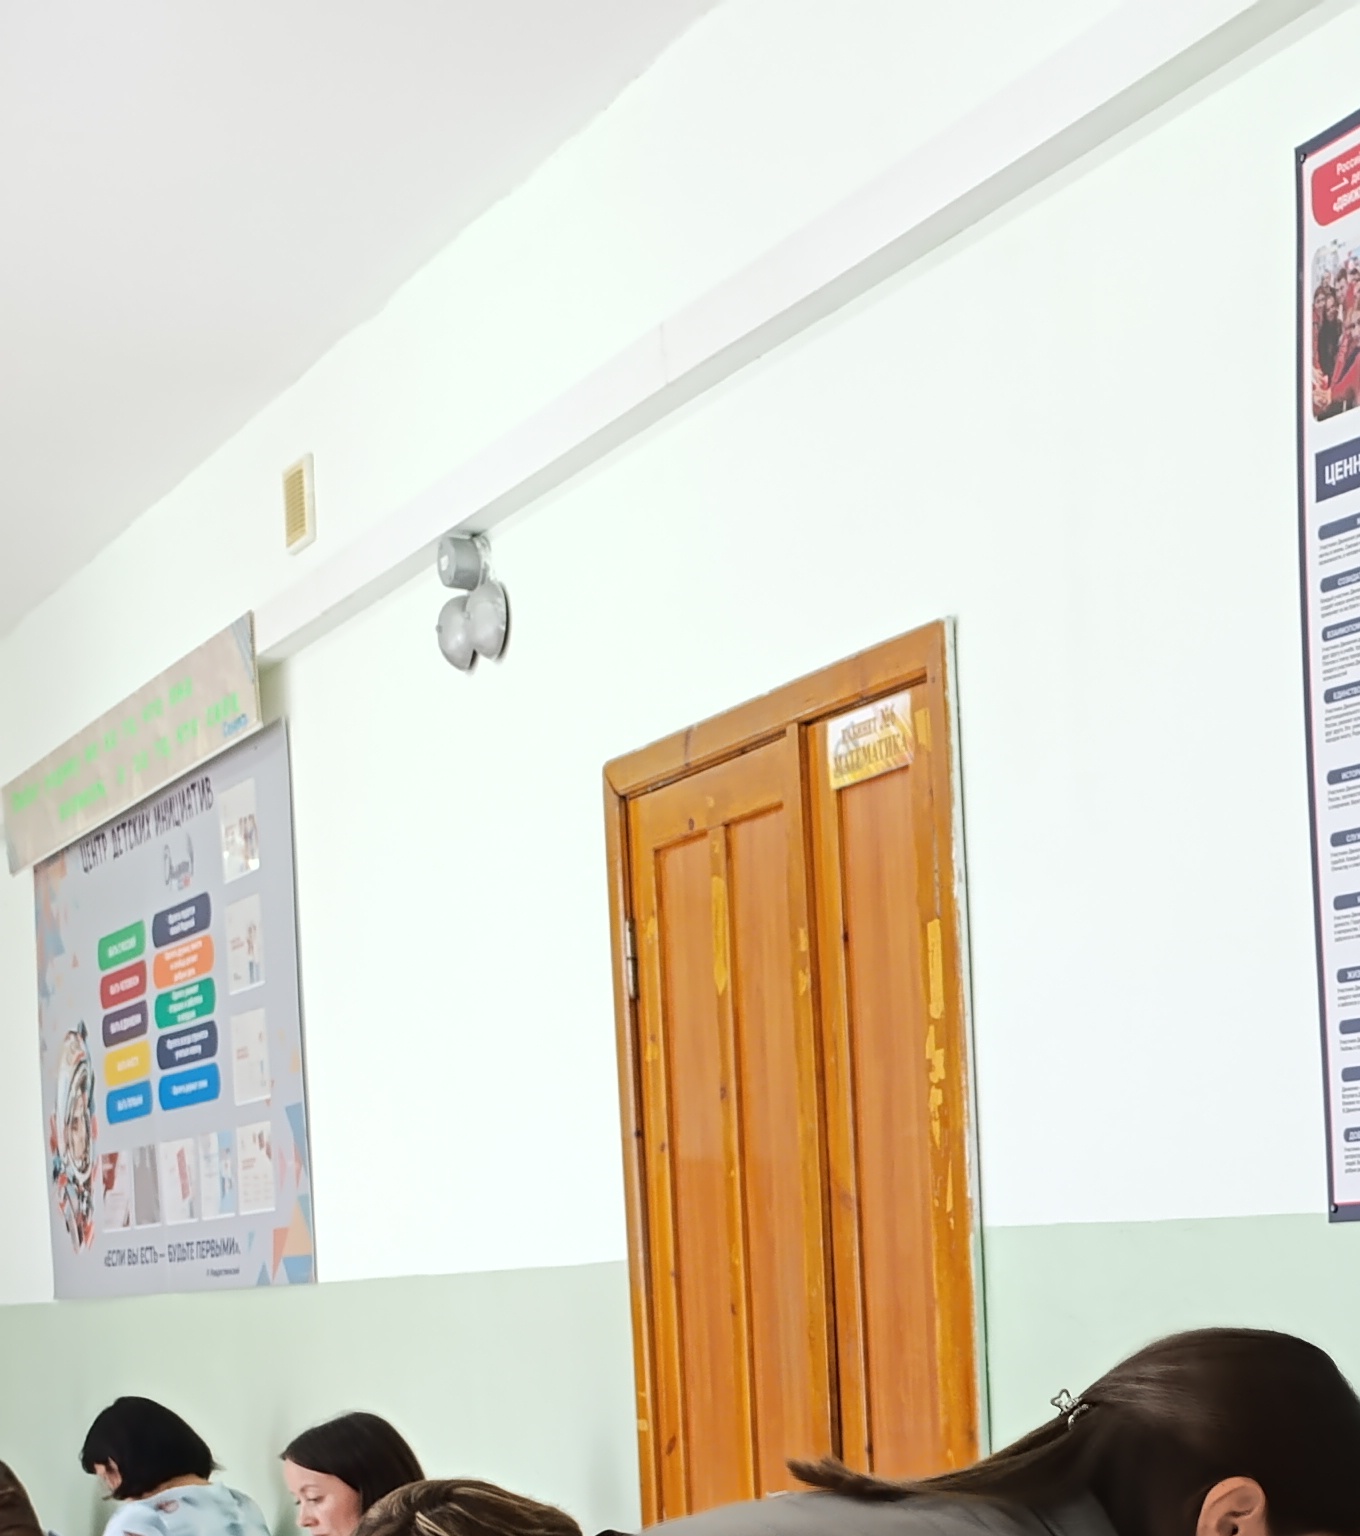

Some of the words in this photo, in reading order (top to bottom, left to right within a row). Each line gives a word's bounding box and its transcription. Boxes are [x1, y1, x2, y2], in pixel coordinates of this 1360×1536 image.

[80, 833, 107, 873] ЦЕНТР
[111, 809, 150, 859] ДЕТСКИХ
[154, 776, 214, 836] ИНИЦИАТИВ
